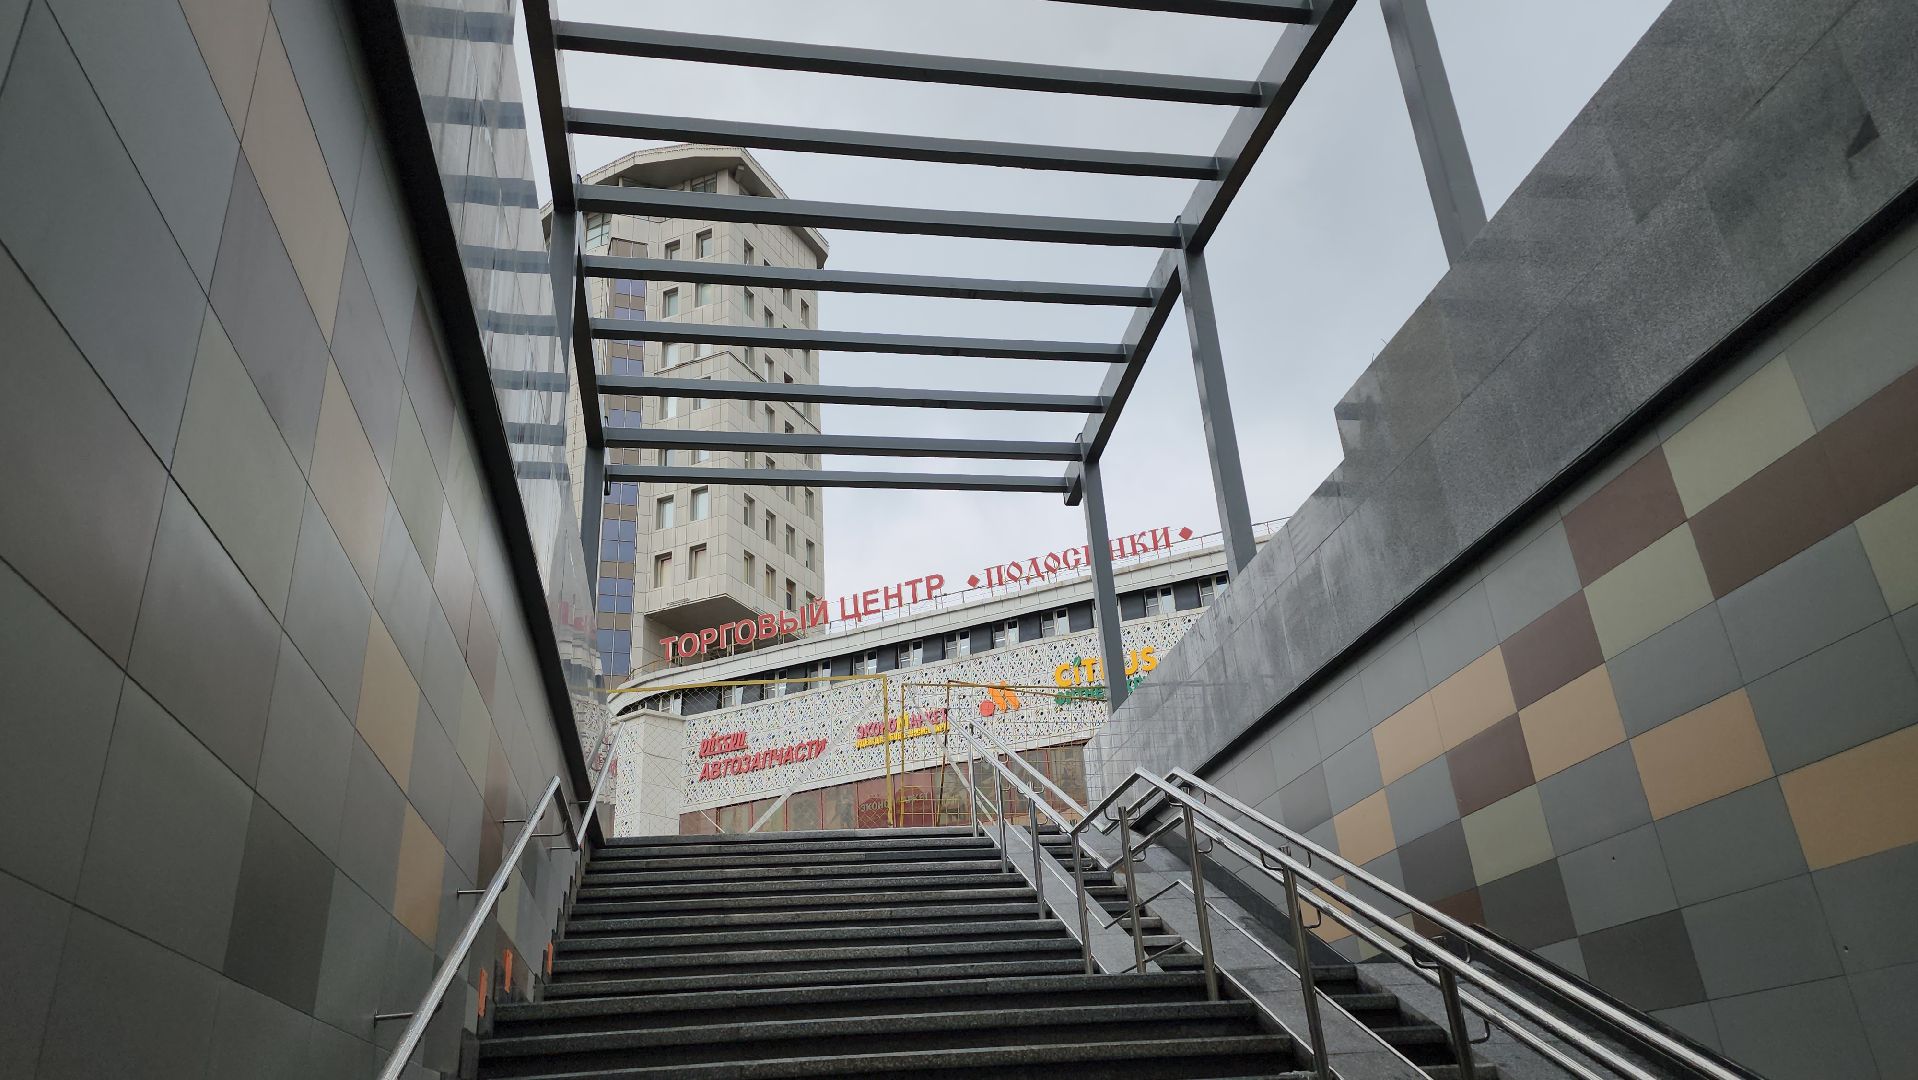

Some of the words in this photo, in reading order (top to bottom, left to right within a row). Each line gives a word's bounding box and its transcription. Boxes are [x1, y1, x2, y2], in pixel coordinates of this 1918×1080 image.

[660, 596, 829, 661] ТОРГОВЫЙ
[840, 574, 945, 622] ЦЕНТР
[699, 738, 828, 781] АВТОЗАПЧАСТИ
